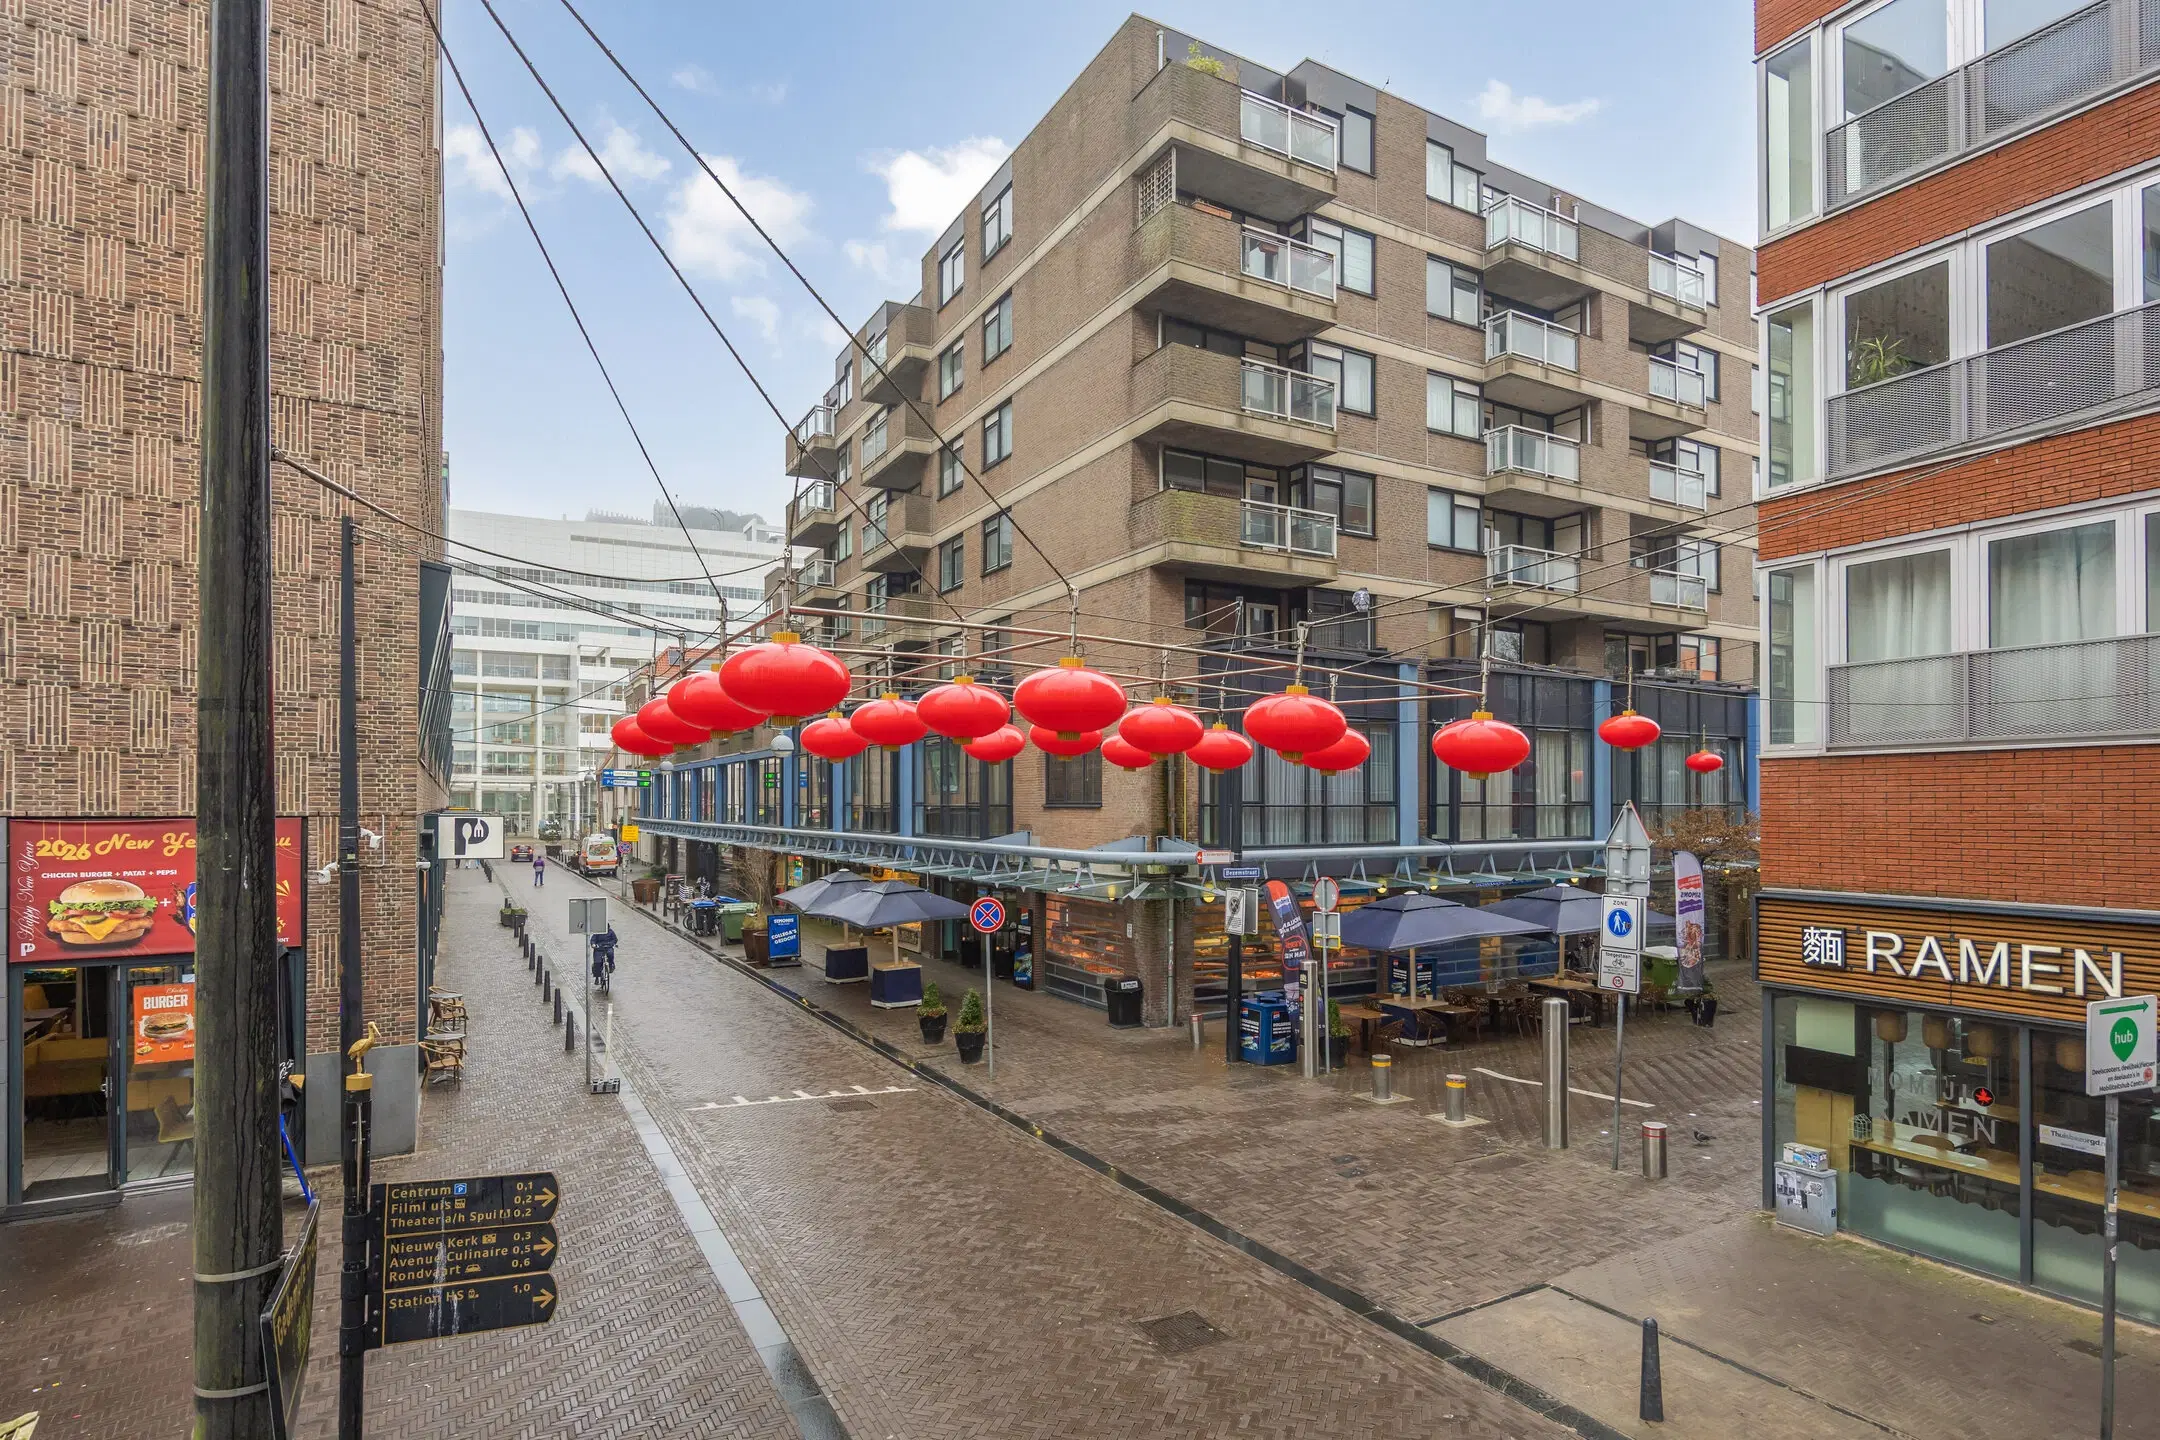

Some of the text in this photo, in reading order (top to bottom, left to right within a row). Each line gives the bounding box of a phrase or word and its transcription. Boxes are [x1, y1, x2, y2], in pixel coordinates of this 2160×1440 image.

[36, 832, 197, 860] 2026 New Ye
[16, 841, 40, 941] Happy New Year
[1866, 930, 2123, 998] RAMEN
[143, 994, 188, 1010] BURGER
[2114, 1030, 2134, 1045] hub
[1867, 1066, 1967, 1104] MOMJI
[391, 1186, 451, 1199] Centrum
[516, 1182, 533, 1192] 0,1
[514, 1195, 533, 1205] 0,2
[390, 1208, 532, 1229] Theater a/h Spui 0,2
[390, 1231, 532, 1255] Nieuwe Kerk 0,3
[389, 1245, 531, 1269] Avenue Culinaire 0,5
[511, 1258, 531, 1268] 0,6
[389, 1283, 531, 1310] Station HS 1,0
